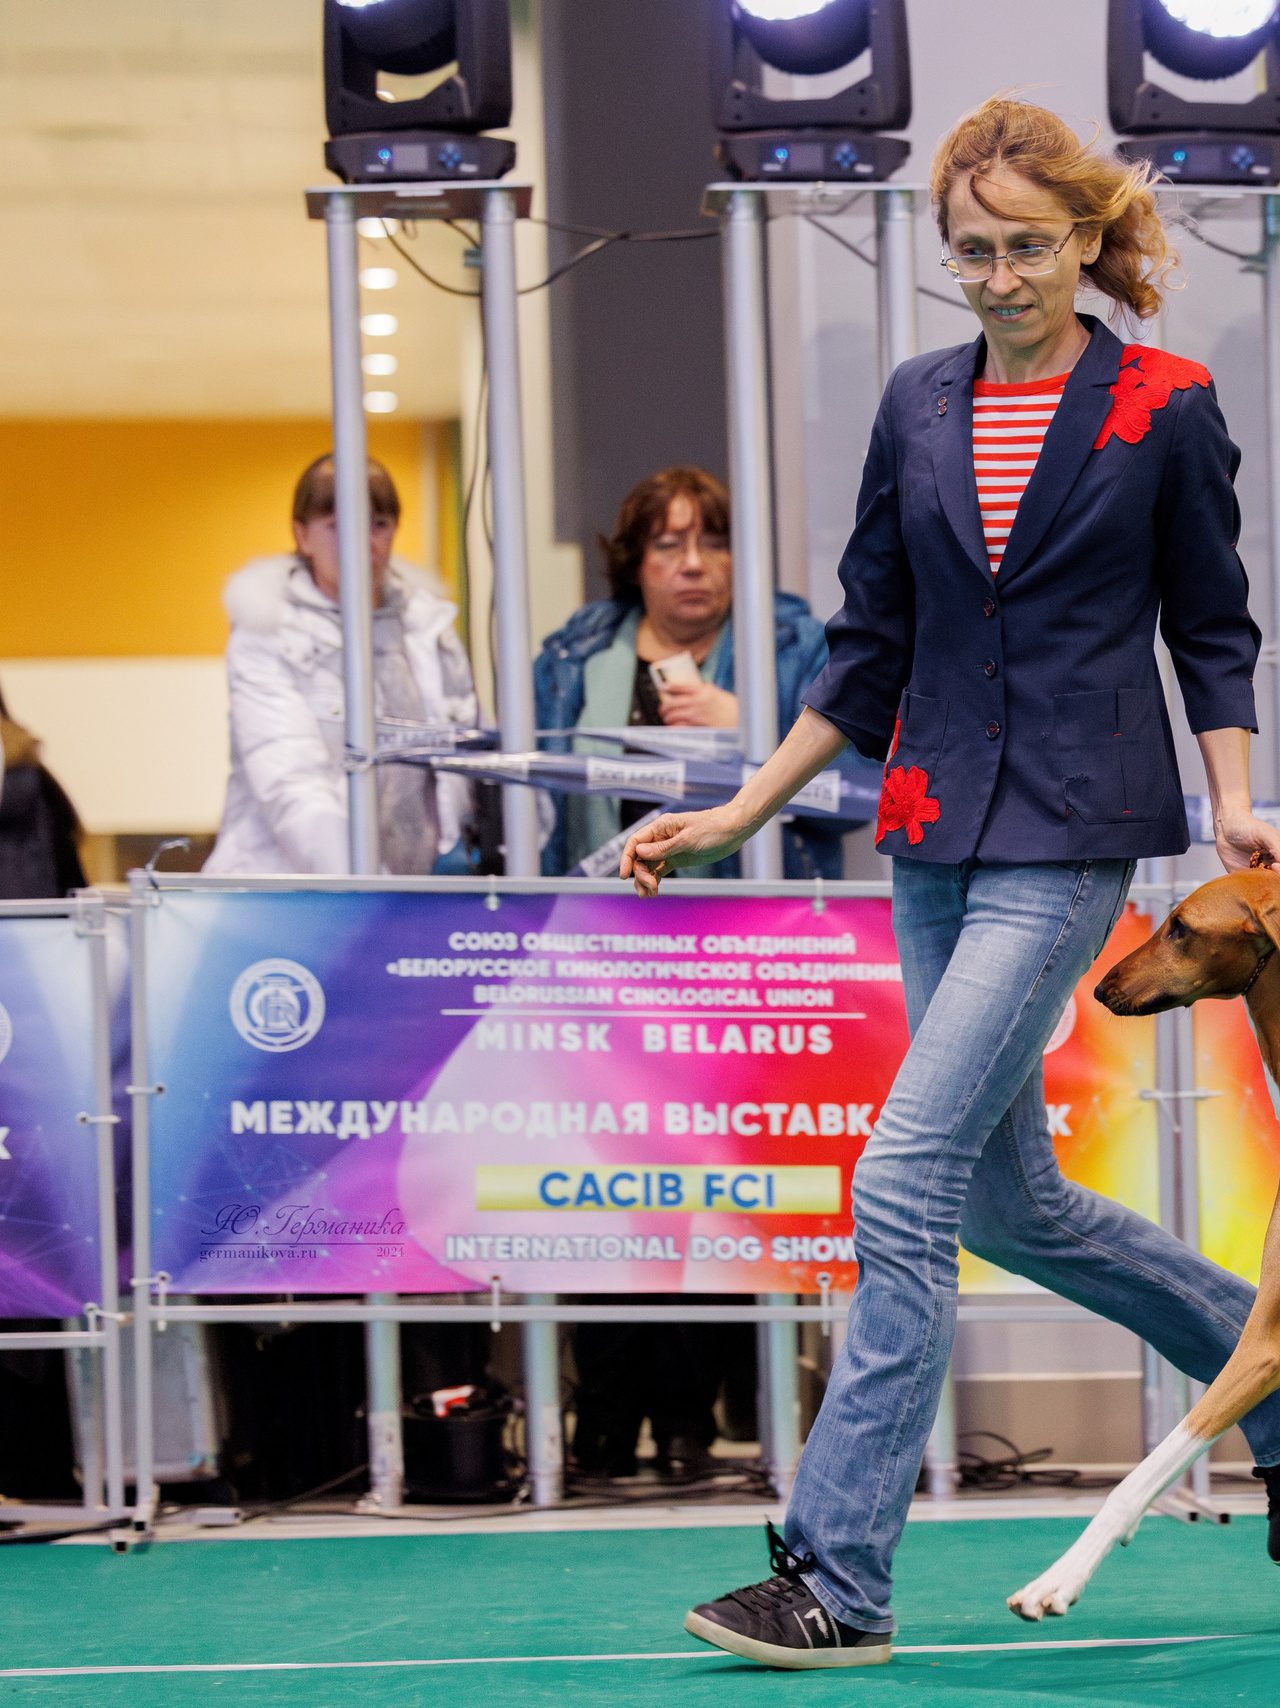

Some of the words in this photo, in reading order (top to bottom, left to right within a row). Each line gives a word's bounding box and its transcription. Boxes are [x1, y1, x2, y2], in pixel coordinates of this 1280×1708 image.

[448, 931, 519, 952] СОЮЗ
[522, 931, 699, 955] ОБЩЕСТВЕННЫХ
[702, 932, 857, 957] ОБЪЕДИНЕНИЙ
[386, 957, 551, 979] «БЕЛОРУССКОЕ
[555, 960, 751, 982] КИНОЛОГИЧЕСКОЕ
[473, 984, 614, 1005] BELORUSSIAN
[617, 986, 763, 1008] CINOLOGICAL
[765, 988, 834, 1007] UNION
[476, 1021, 612, 1053] MINSK
[642, 1023, 834, 1055] BELARUS
[231, 1100, 649, 1140] МЕЖДУНАРОДНАЯ
[538, 1171, 685, 1208] CACIB
[703, 1173, 776, 1208] FCI
[444, 1234, 682, 1262] INTERNATIONAL
[689, 1236, 763, 1262] DOG
[770, 1235, 859, 1263] SHOW
